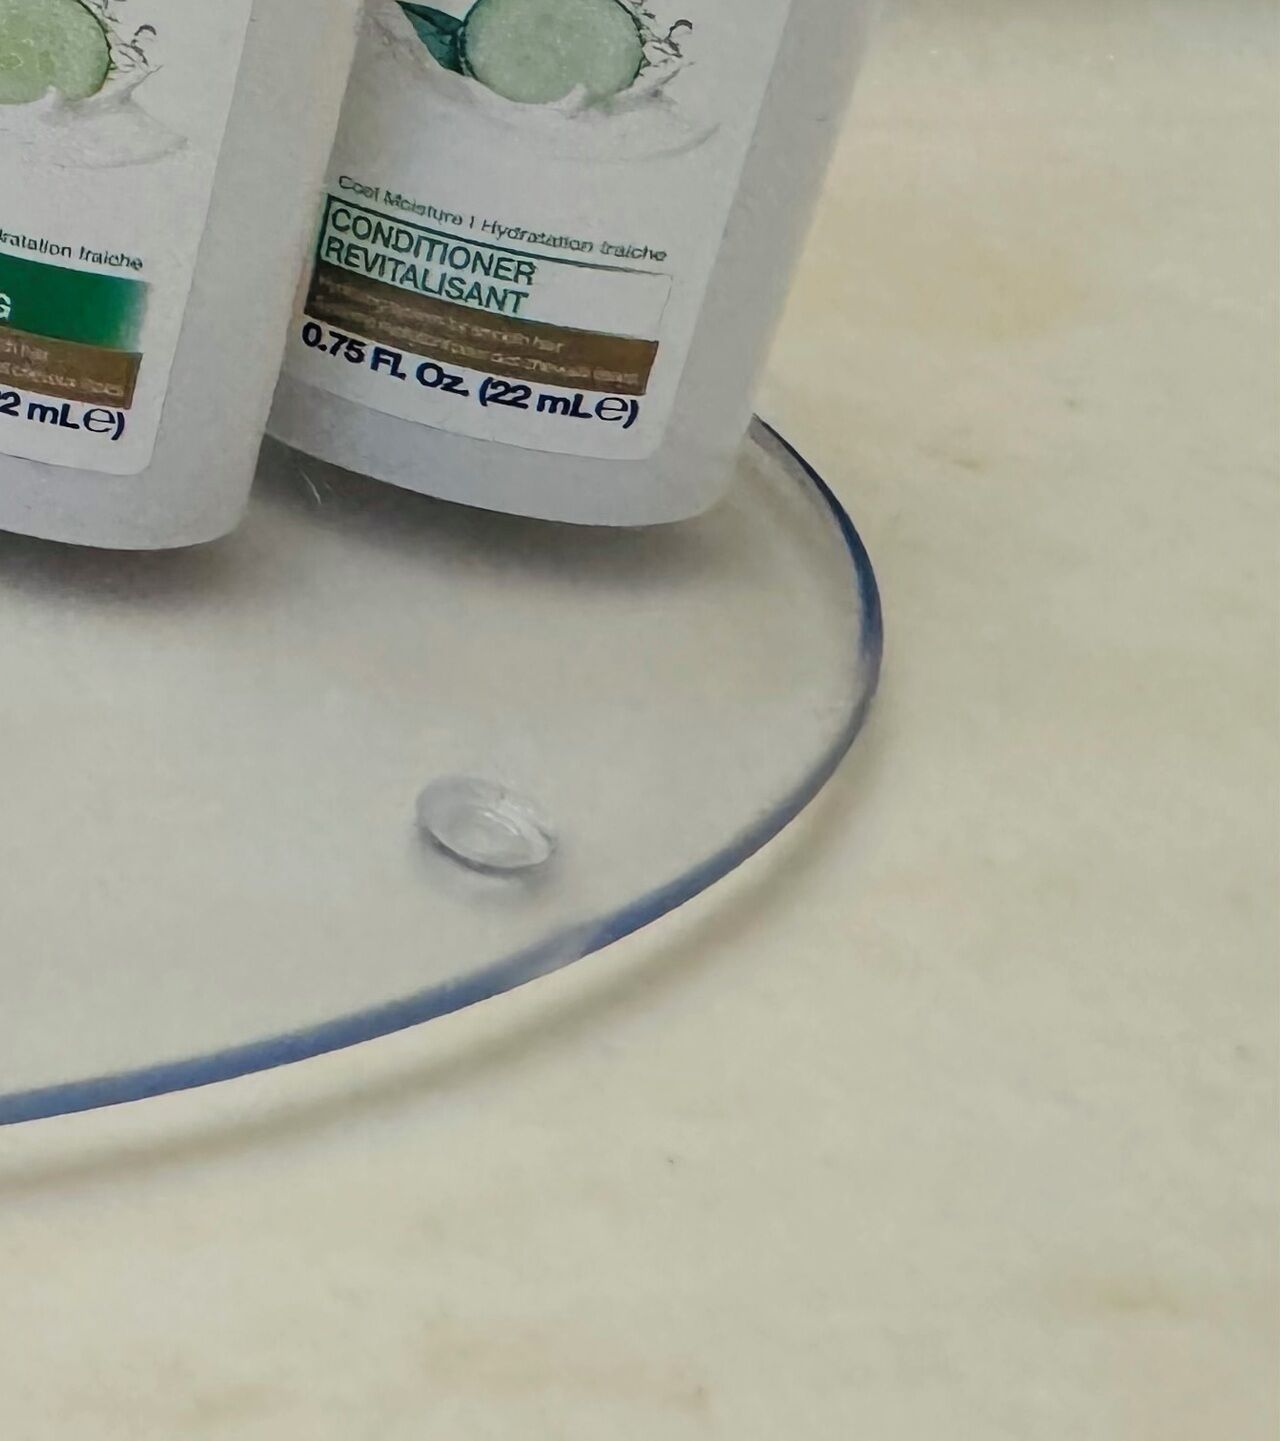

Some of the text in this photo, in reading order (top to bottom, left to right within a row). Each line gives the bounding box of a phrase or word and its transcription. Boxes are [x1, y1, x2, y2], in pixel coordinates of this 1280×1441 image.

[339, 175, 380, 202] Cool
[325, 236, 530, 314] REVITALISANT
[331, 208, 536, 285] CONDITIONER
[302, 321, 365, 364] 0.75
[479, 376, 531, 409] (22
